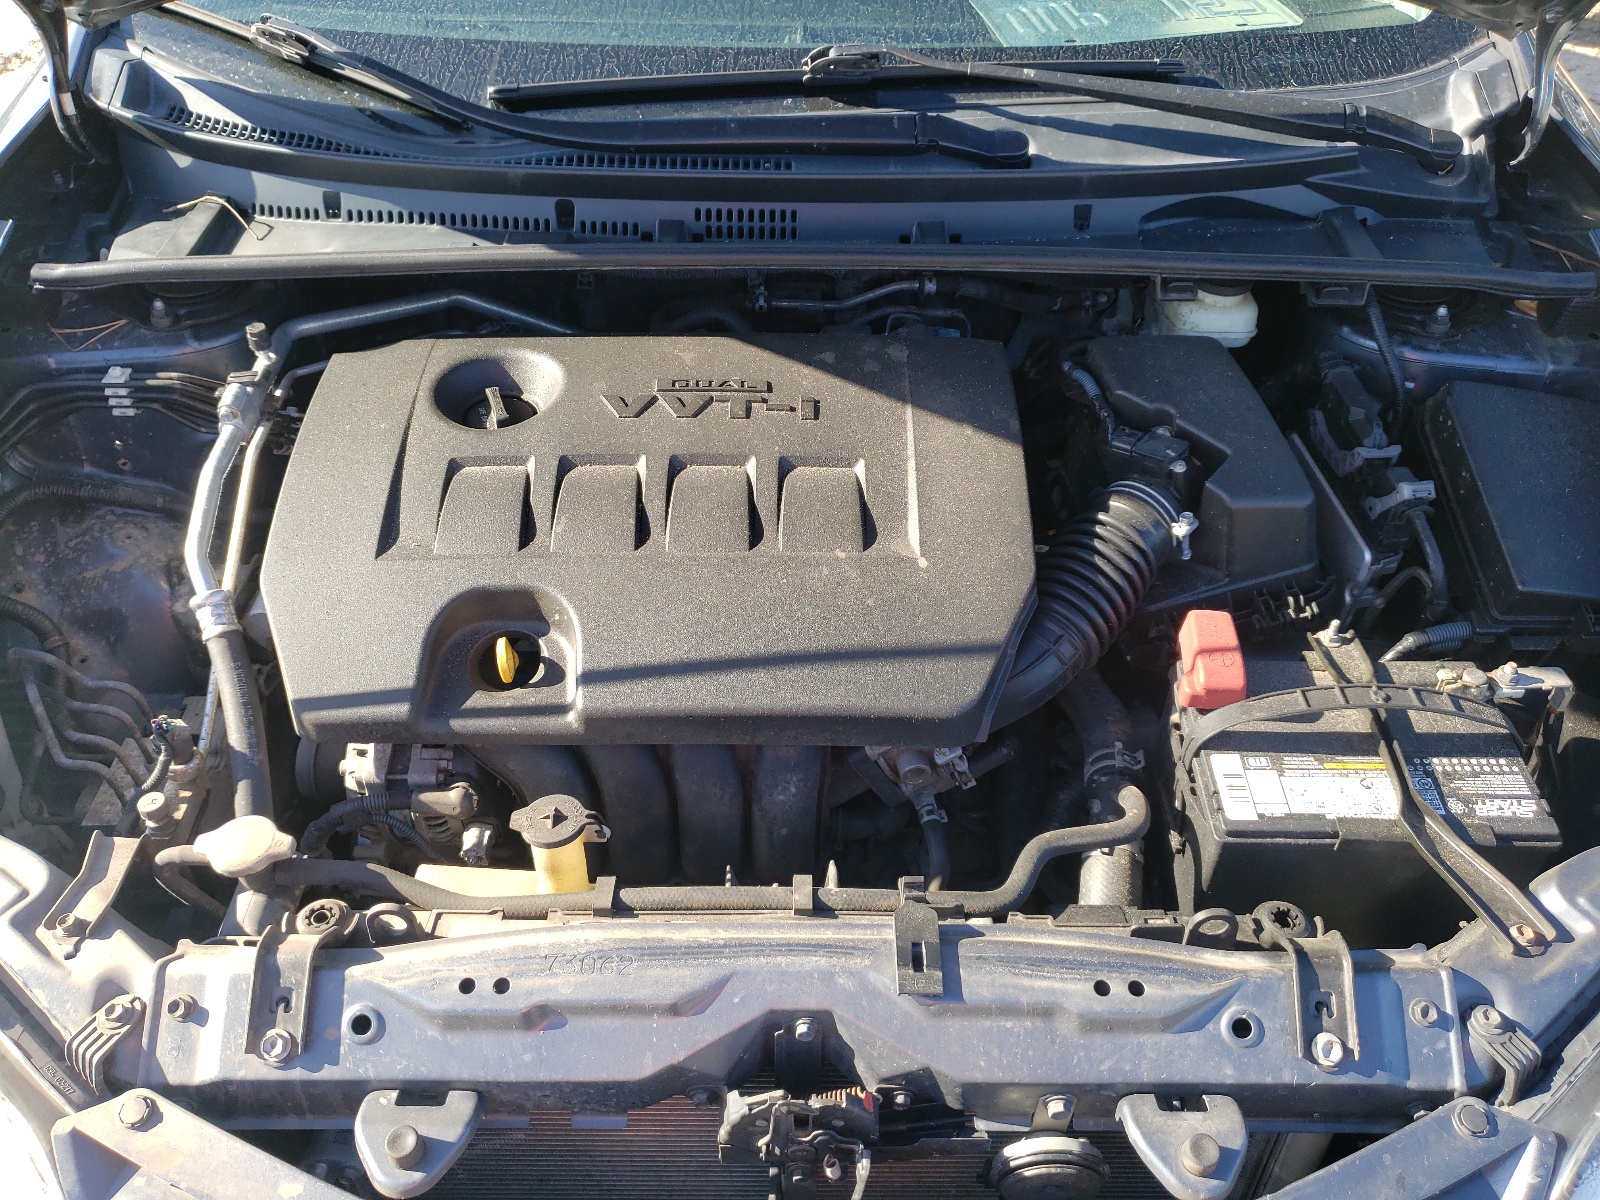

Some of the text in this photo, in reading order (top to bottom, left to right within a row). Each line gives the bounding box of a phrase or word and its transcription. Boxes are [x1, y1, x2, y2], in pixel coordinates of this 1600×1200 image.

[670, 379, 758, 389] DUAL
[1473, 799, 1537, 810] START
[1475, 806, 1534, 818] SUPER
[545, 953, 638, 976] 73062
